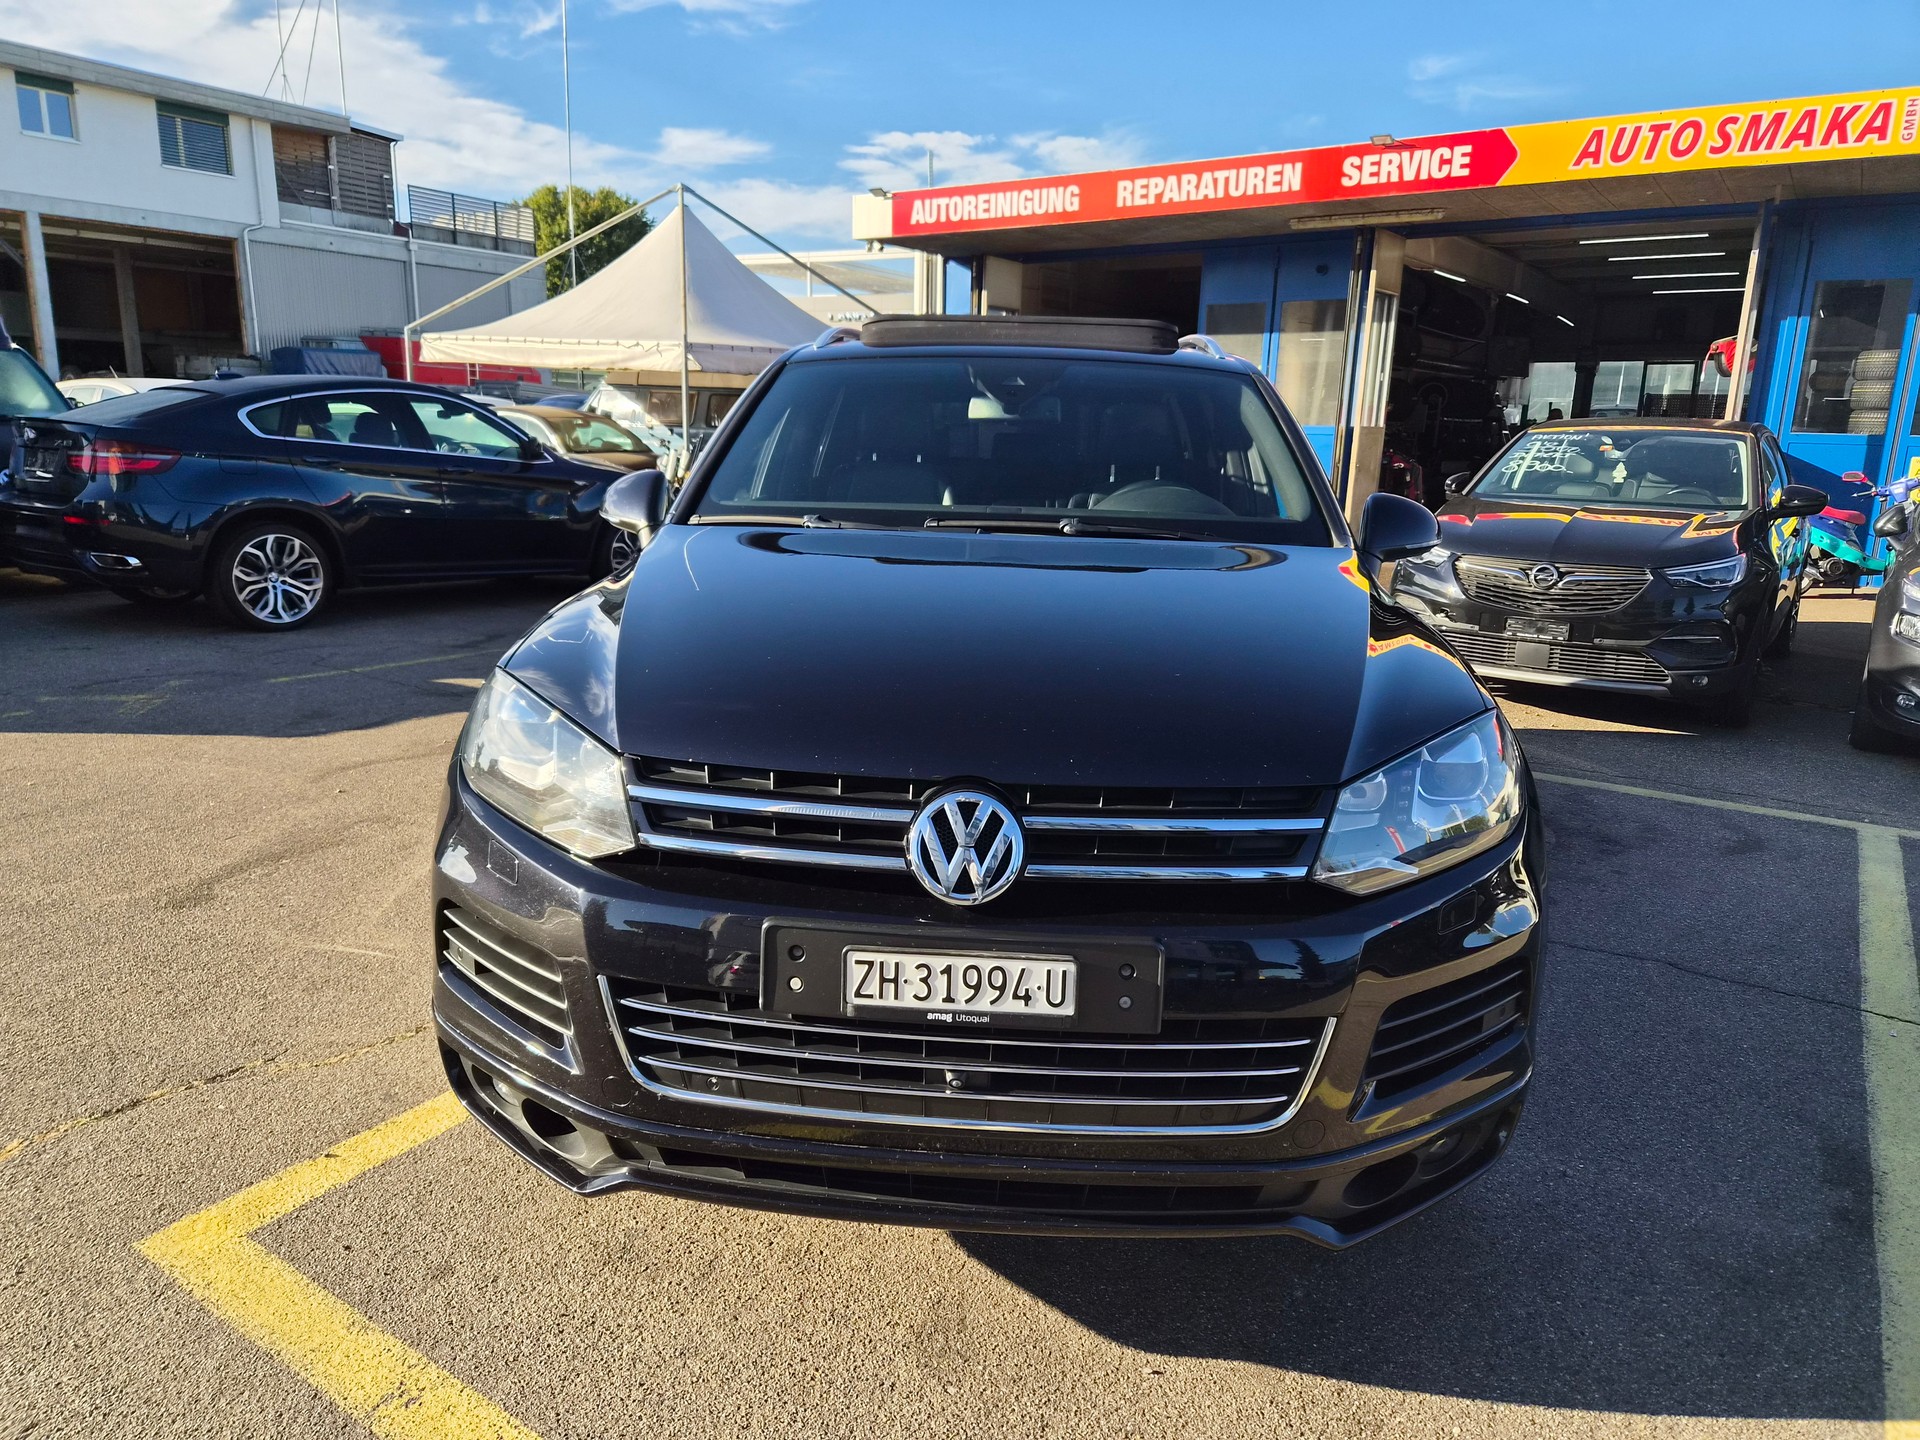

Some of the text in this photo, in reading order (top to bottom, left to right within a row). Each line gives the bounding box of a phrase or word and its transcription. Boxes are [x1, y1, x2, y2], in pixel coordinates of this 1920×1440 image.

[1573, 101, 1894, 167] AUTO SMAKA
[1902, 98, 1919, 141] GMBH
[910, 145, 1473, 226] AUTOREINIGUNG REPARATUREN SERVICE
[927, 1012, 990, 1023] amag Utoquai
